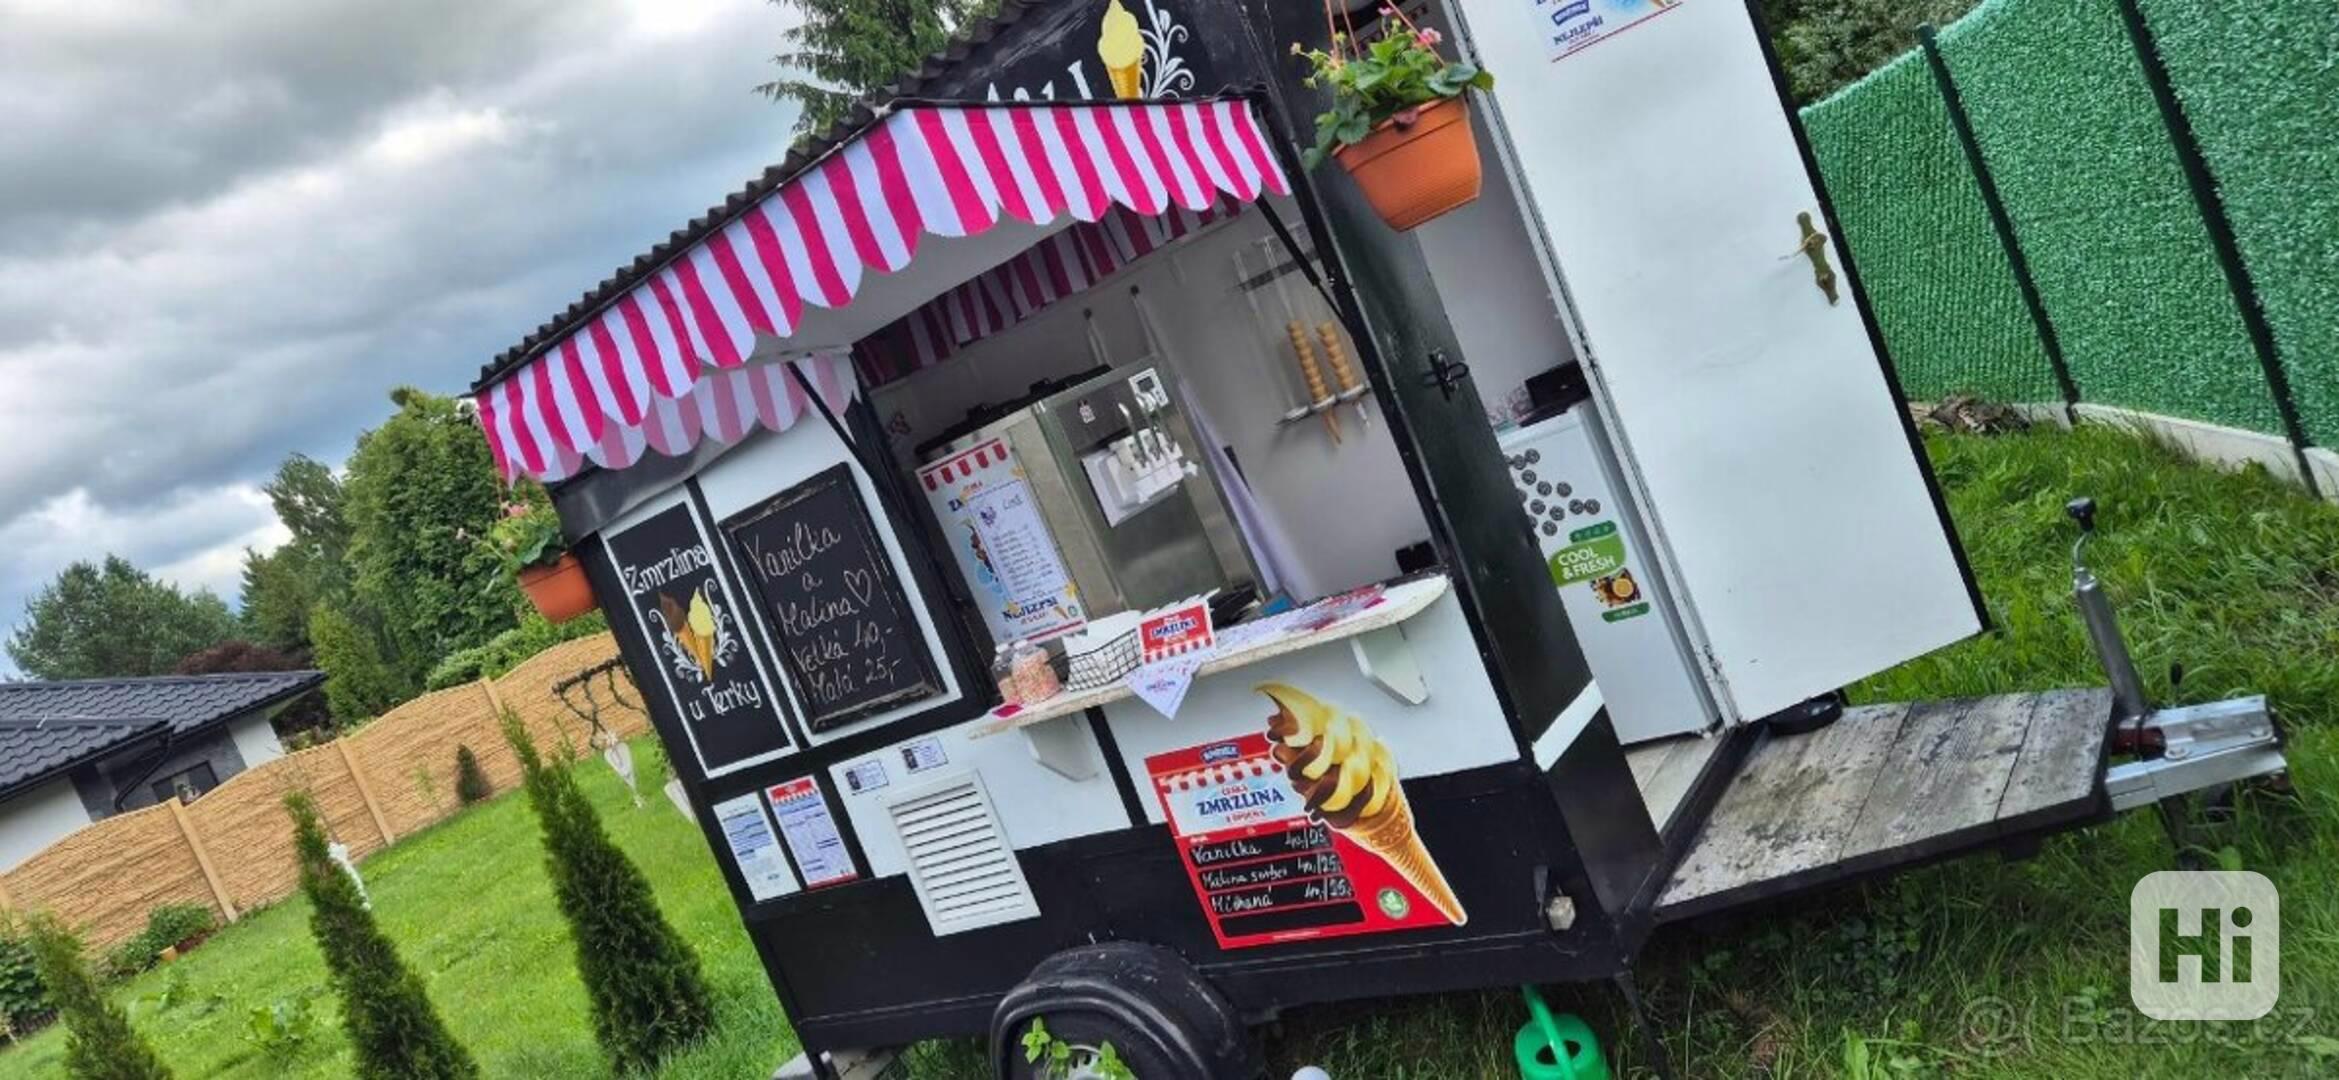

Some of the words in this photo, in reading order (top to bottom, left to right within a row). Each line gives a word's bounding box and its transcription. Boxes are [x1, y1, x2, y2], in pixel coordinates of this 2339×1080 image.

[624, 544, 712, 597] Zmrzlina
[743, 521, 842, 584] Vanilka
[1558, 546, 1600, 567] COOL
[802, 572, 824, 592] a
[777, 596, 860, 636] Malina
[790, 628, 849, 673] Velká
[689, 700, 706, 721] u
[701, 683, 762, 717] Terky
[808, 663, 860, 704] Malá
[1196, 788, 1286, 816] ZMRZLINA
[1191, 840, 1262, 864] Vanilka
[1202, 867, 1247, 888] Malina
